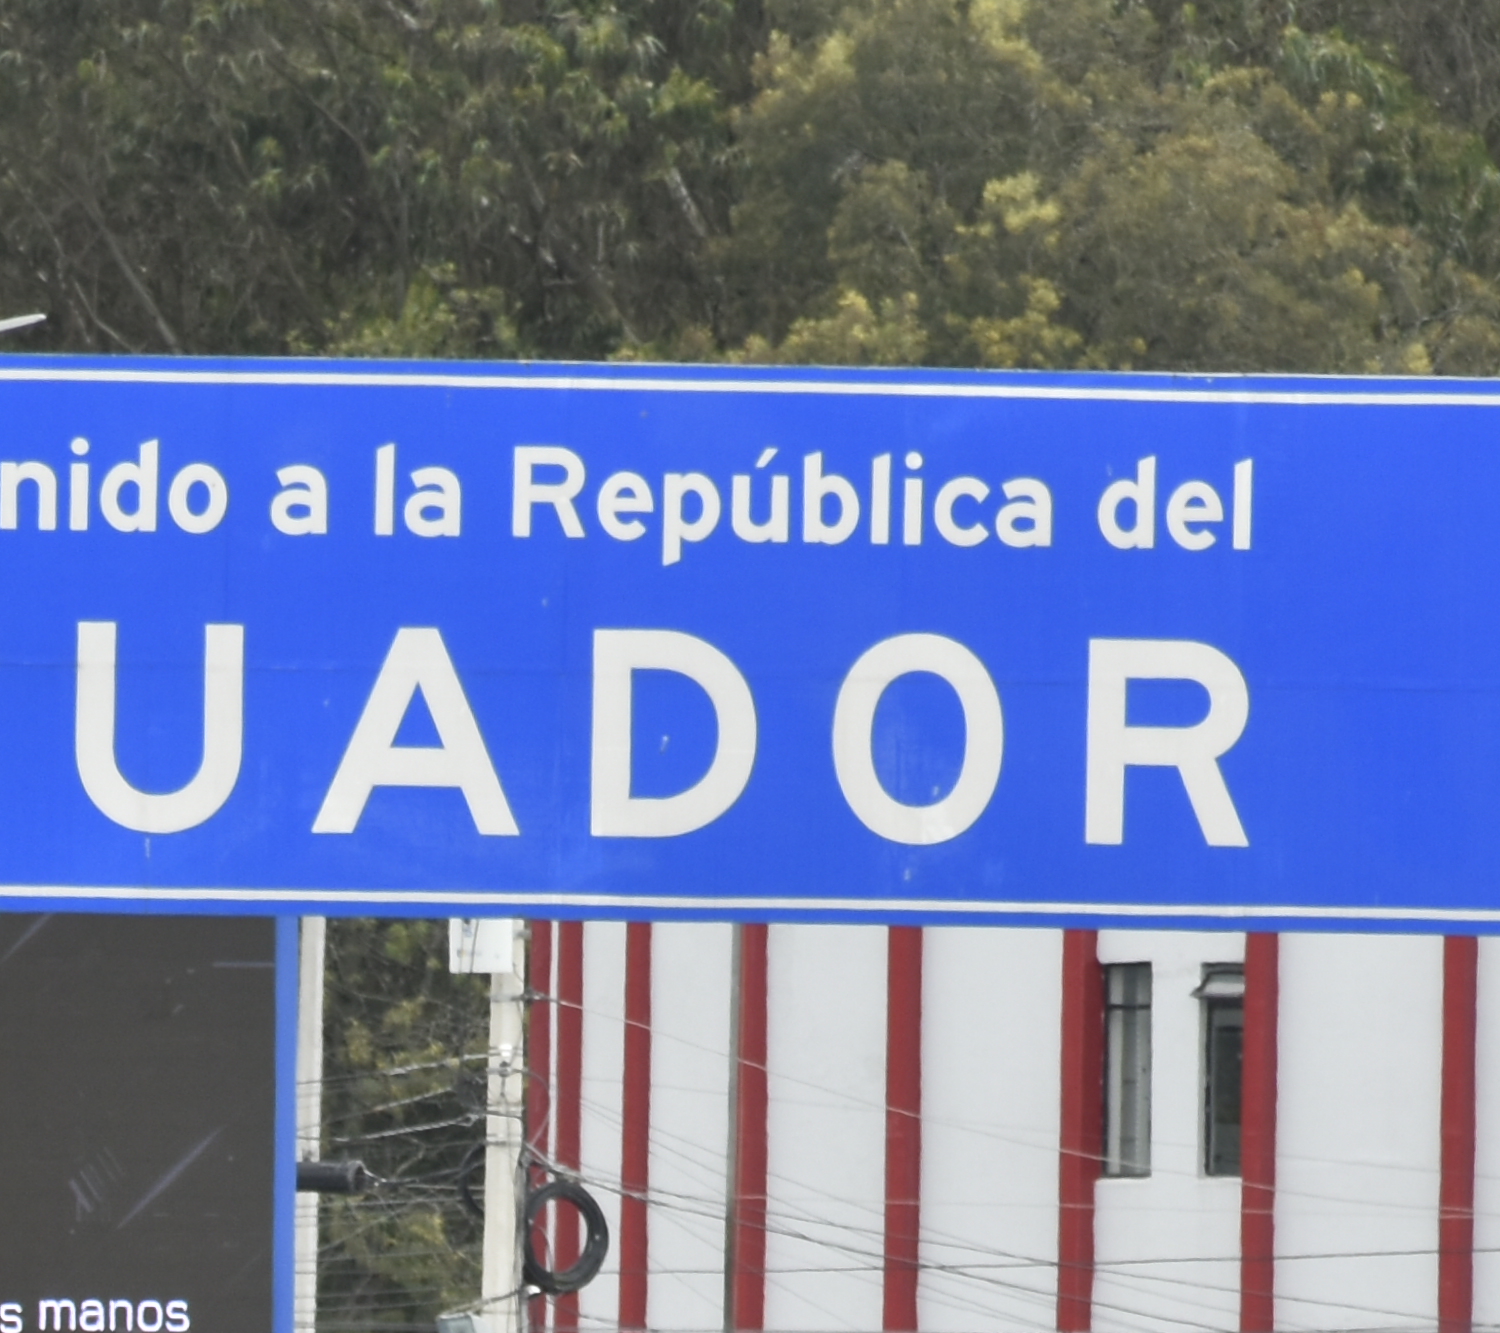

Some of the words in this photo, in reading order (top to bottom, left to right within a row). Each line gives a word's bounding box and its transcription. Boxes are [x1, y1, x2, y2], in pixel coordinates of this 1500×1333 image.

[268, 464, 330, 542] a
[370, 440, 467, 545] la
[511, 444, 1060, 570] República
[1096, 452, 1257, 554] del
